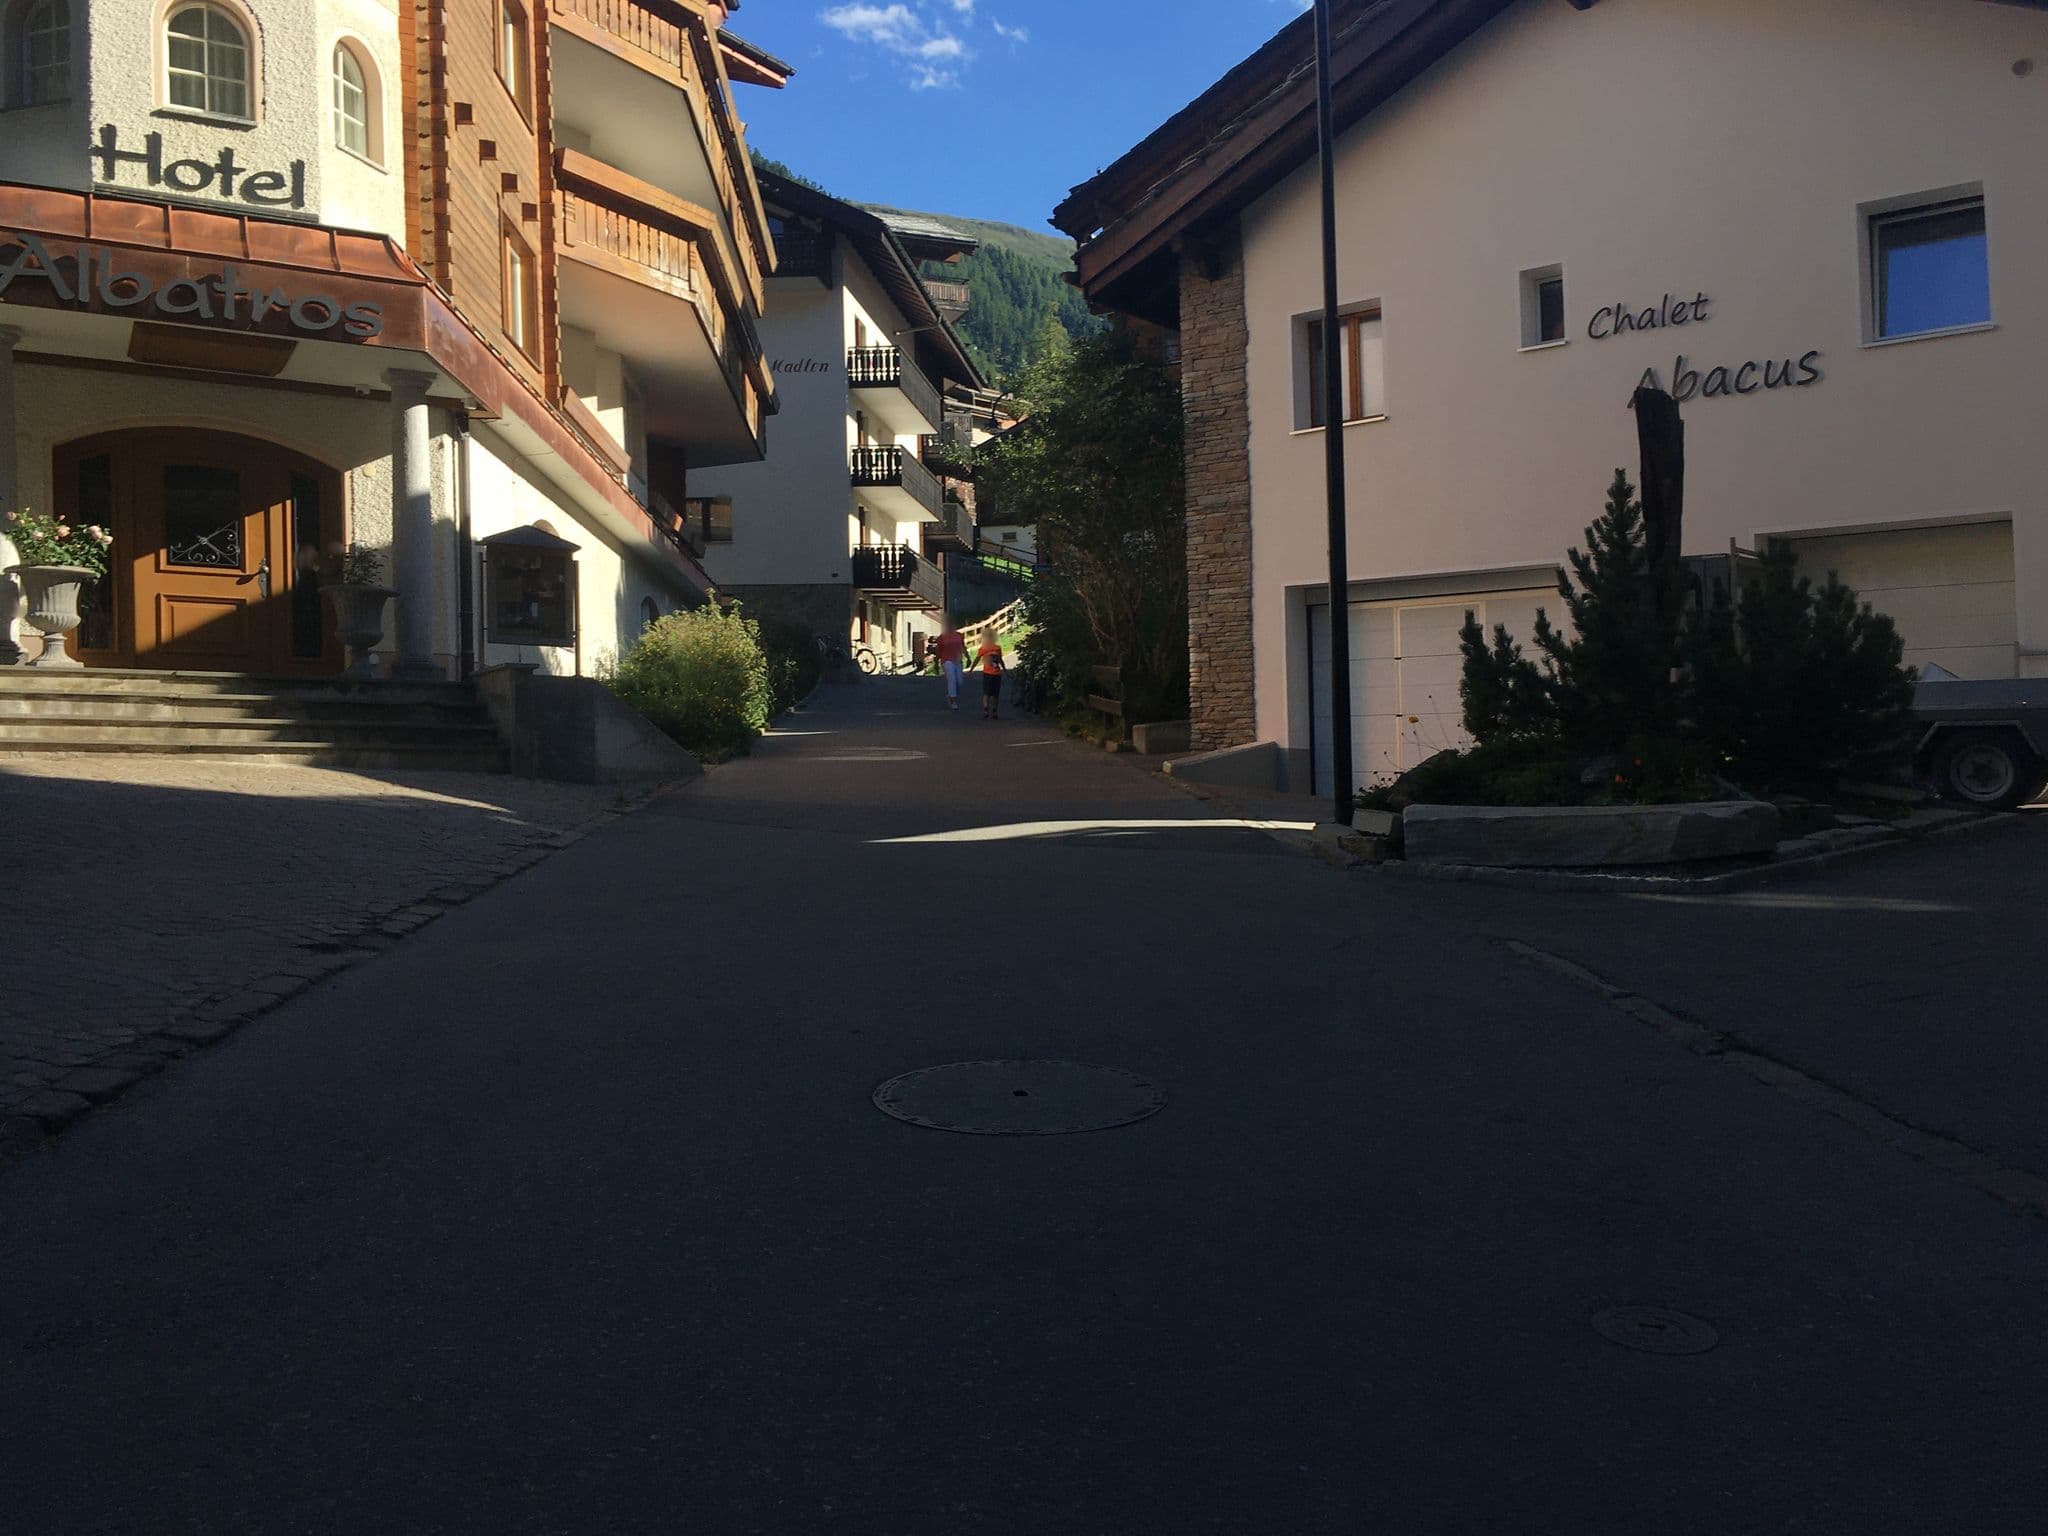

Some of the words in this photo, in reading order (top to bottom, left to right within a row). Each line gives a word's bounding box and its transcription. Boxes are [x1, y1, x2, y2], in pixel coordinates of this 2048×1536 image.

[89, 124, 304, 209] Hotel
[0, 233, 384, 337] Albatros
[1588, 292, 1709, 339] Chalet
